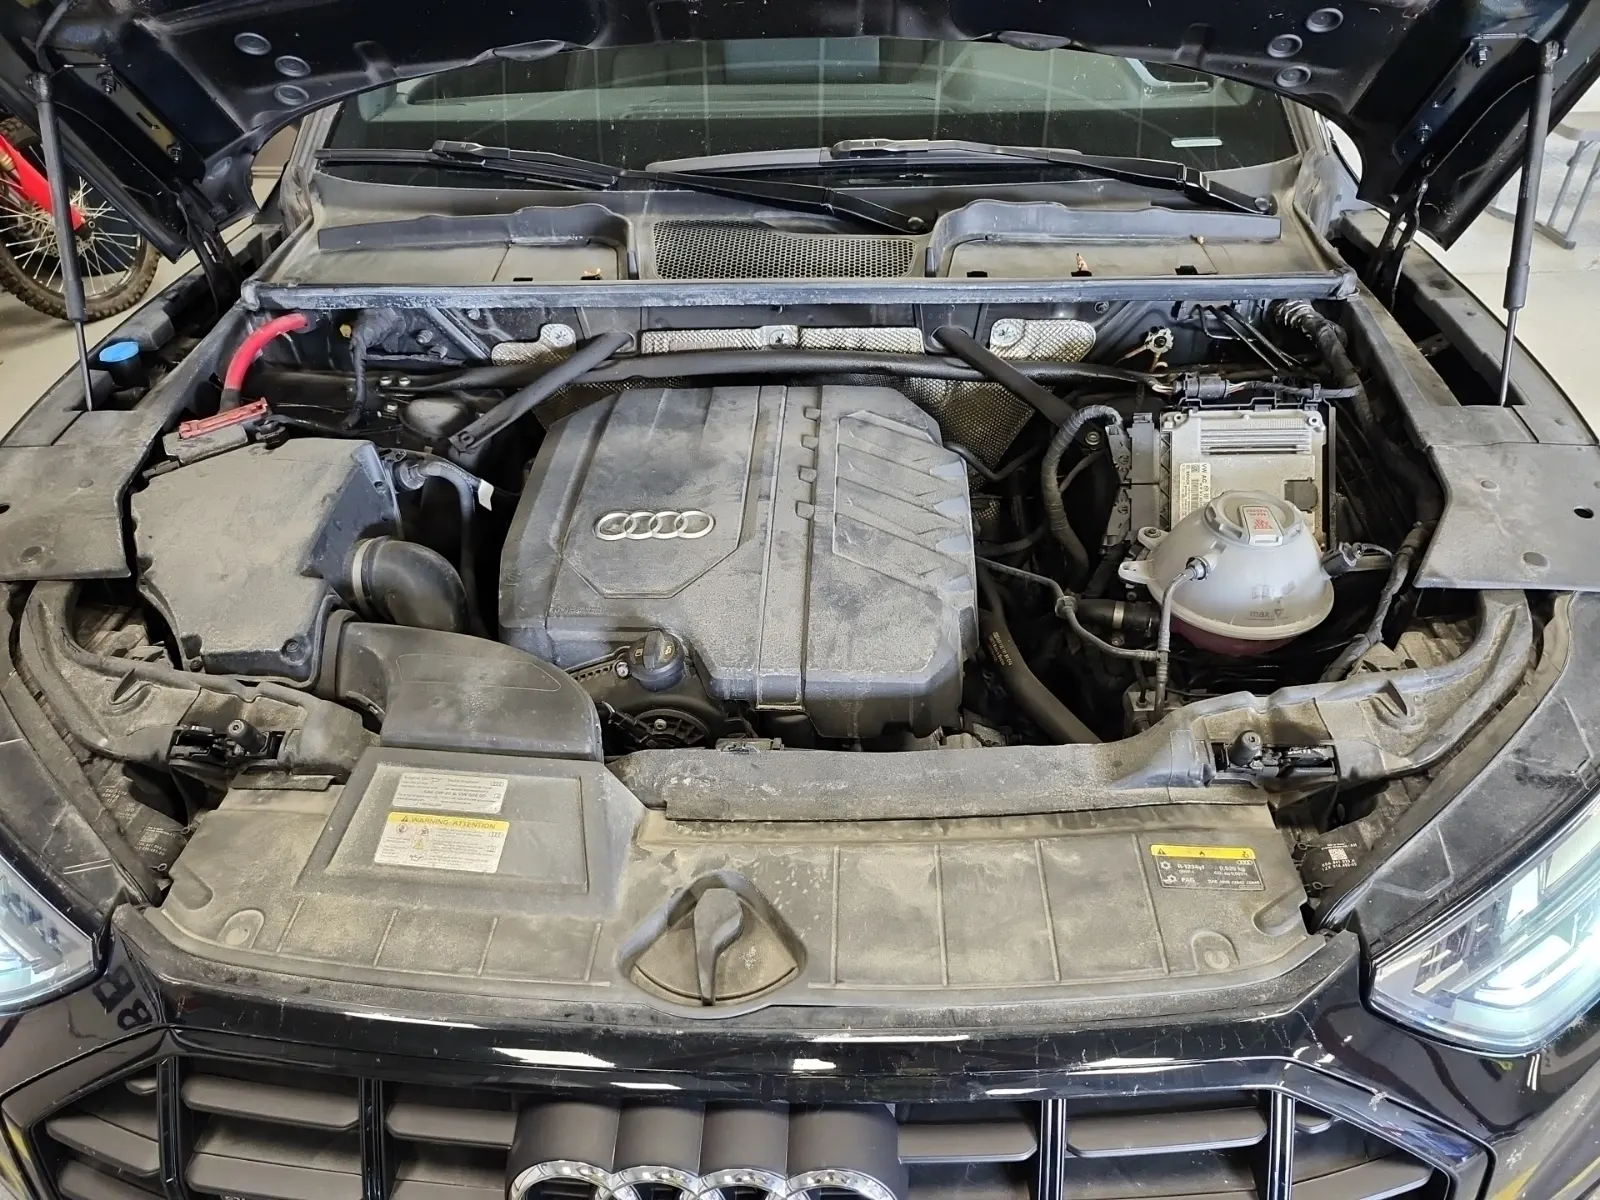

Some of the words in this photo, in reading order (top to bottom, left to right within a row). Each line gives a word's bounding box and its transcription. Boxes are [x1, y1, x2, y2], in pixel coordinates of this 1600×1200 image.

[1250, 610, 1270, 618] max
[411, 816, 449, 826] WARNING
[452, 820, 497, 830] ATTENTION
